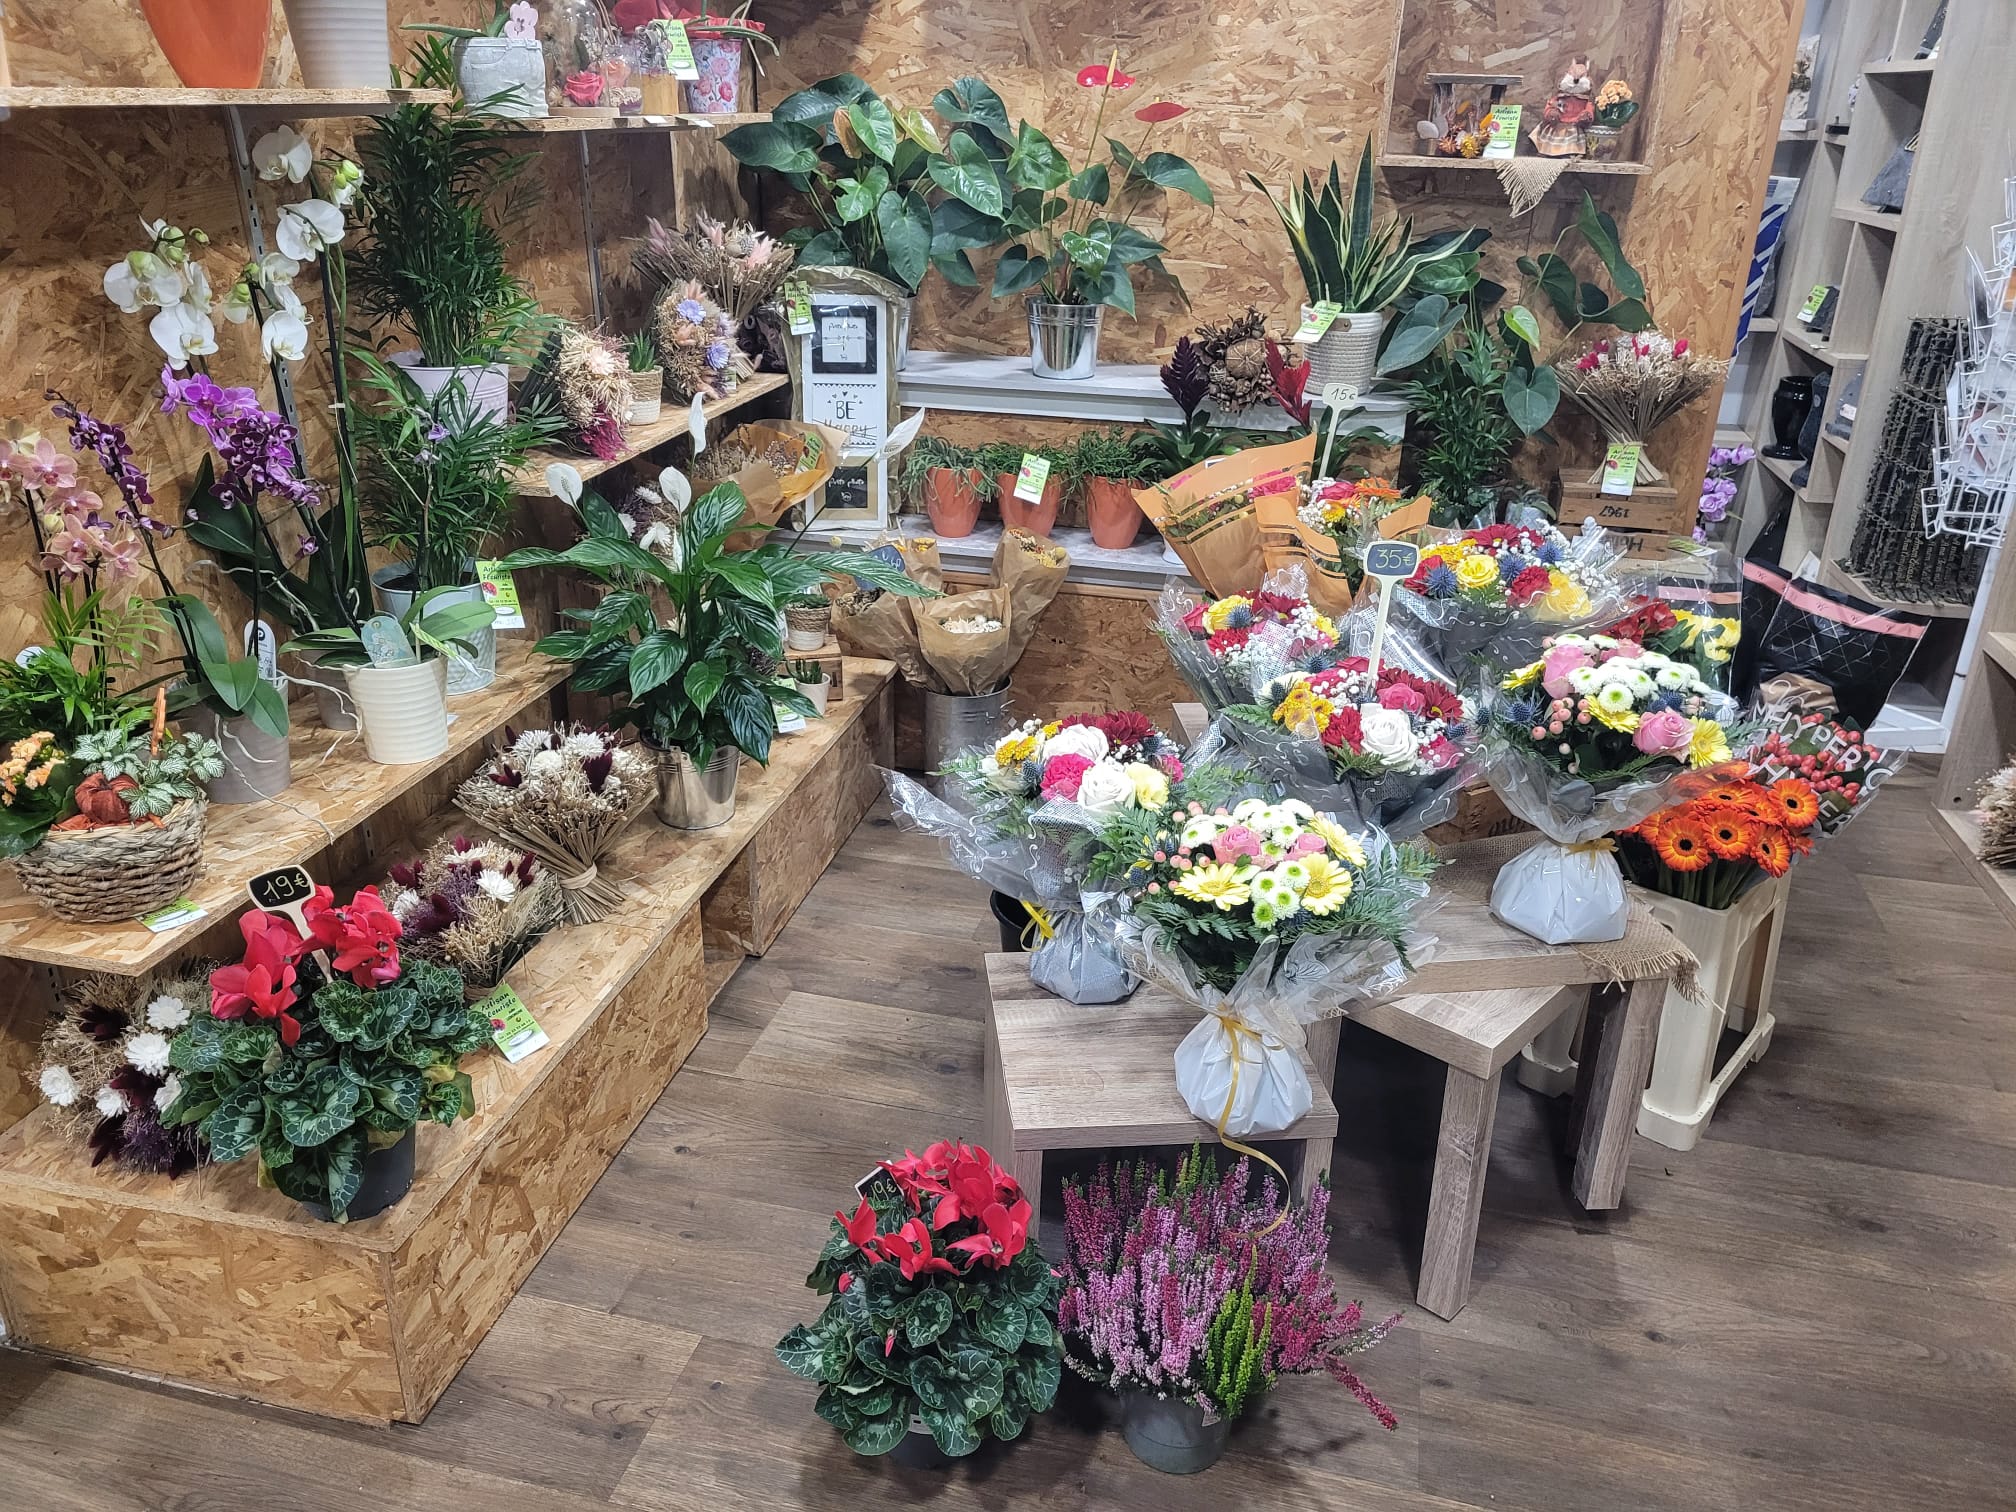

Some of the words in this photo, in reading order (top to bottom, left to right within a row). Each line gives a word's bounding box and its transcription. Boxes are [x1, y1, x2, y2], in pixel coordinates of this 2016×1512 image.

[835, 400, 857, 420] BE
[1375, 548, 1415, 569] 35€
[263, 873, 310, 900] 19€
